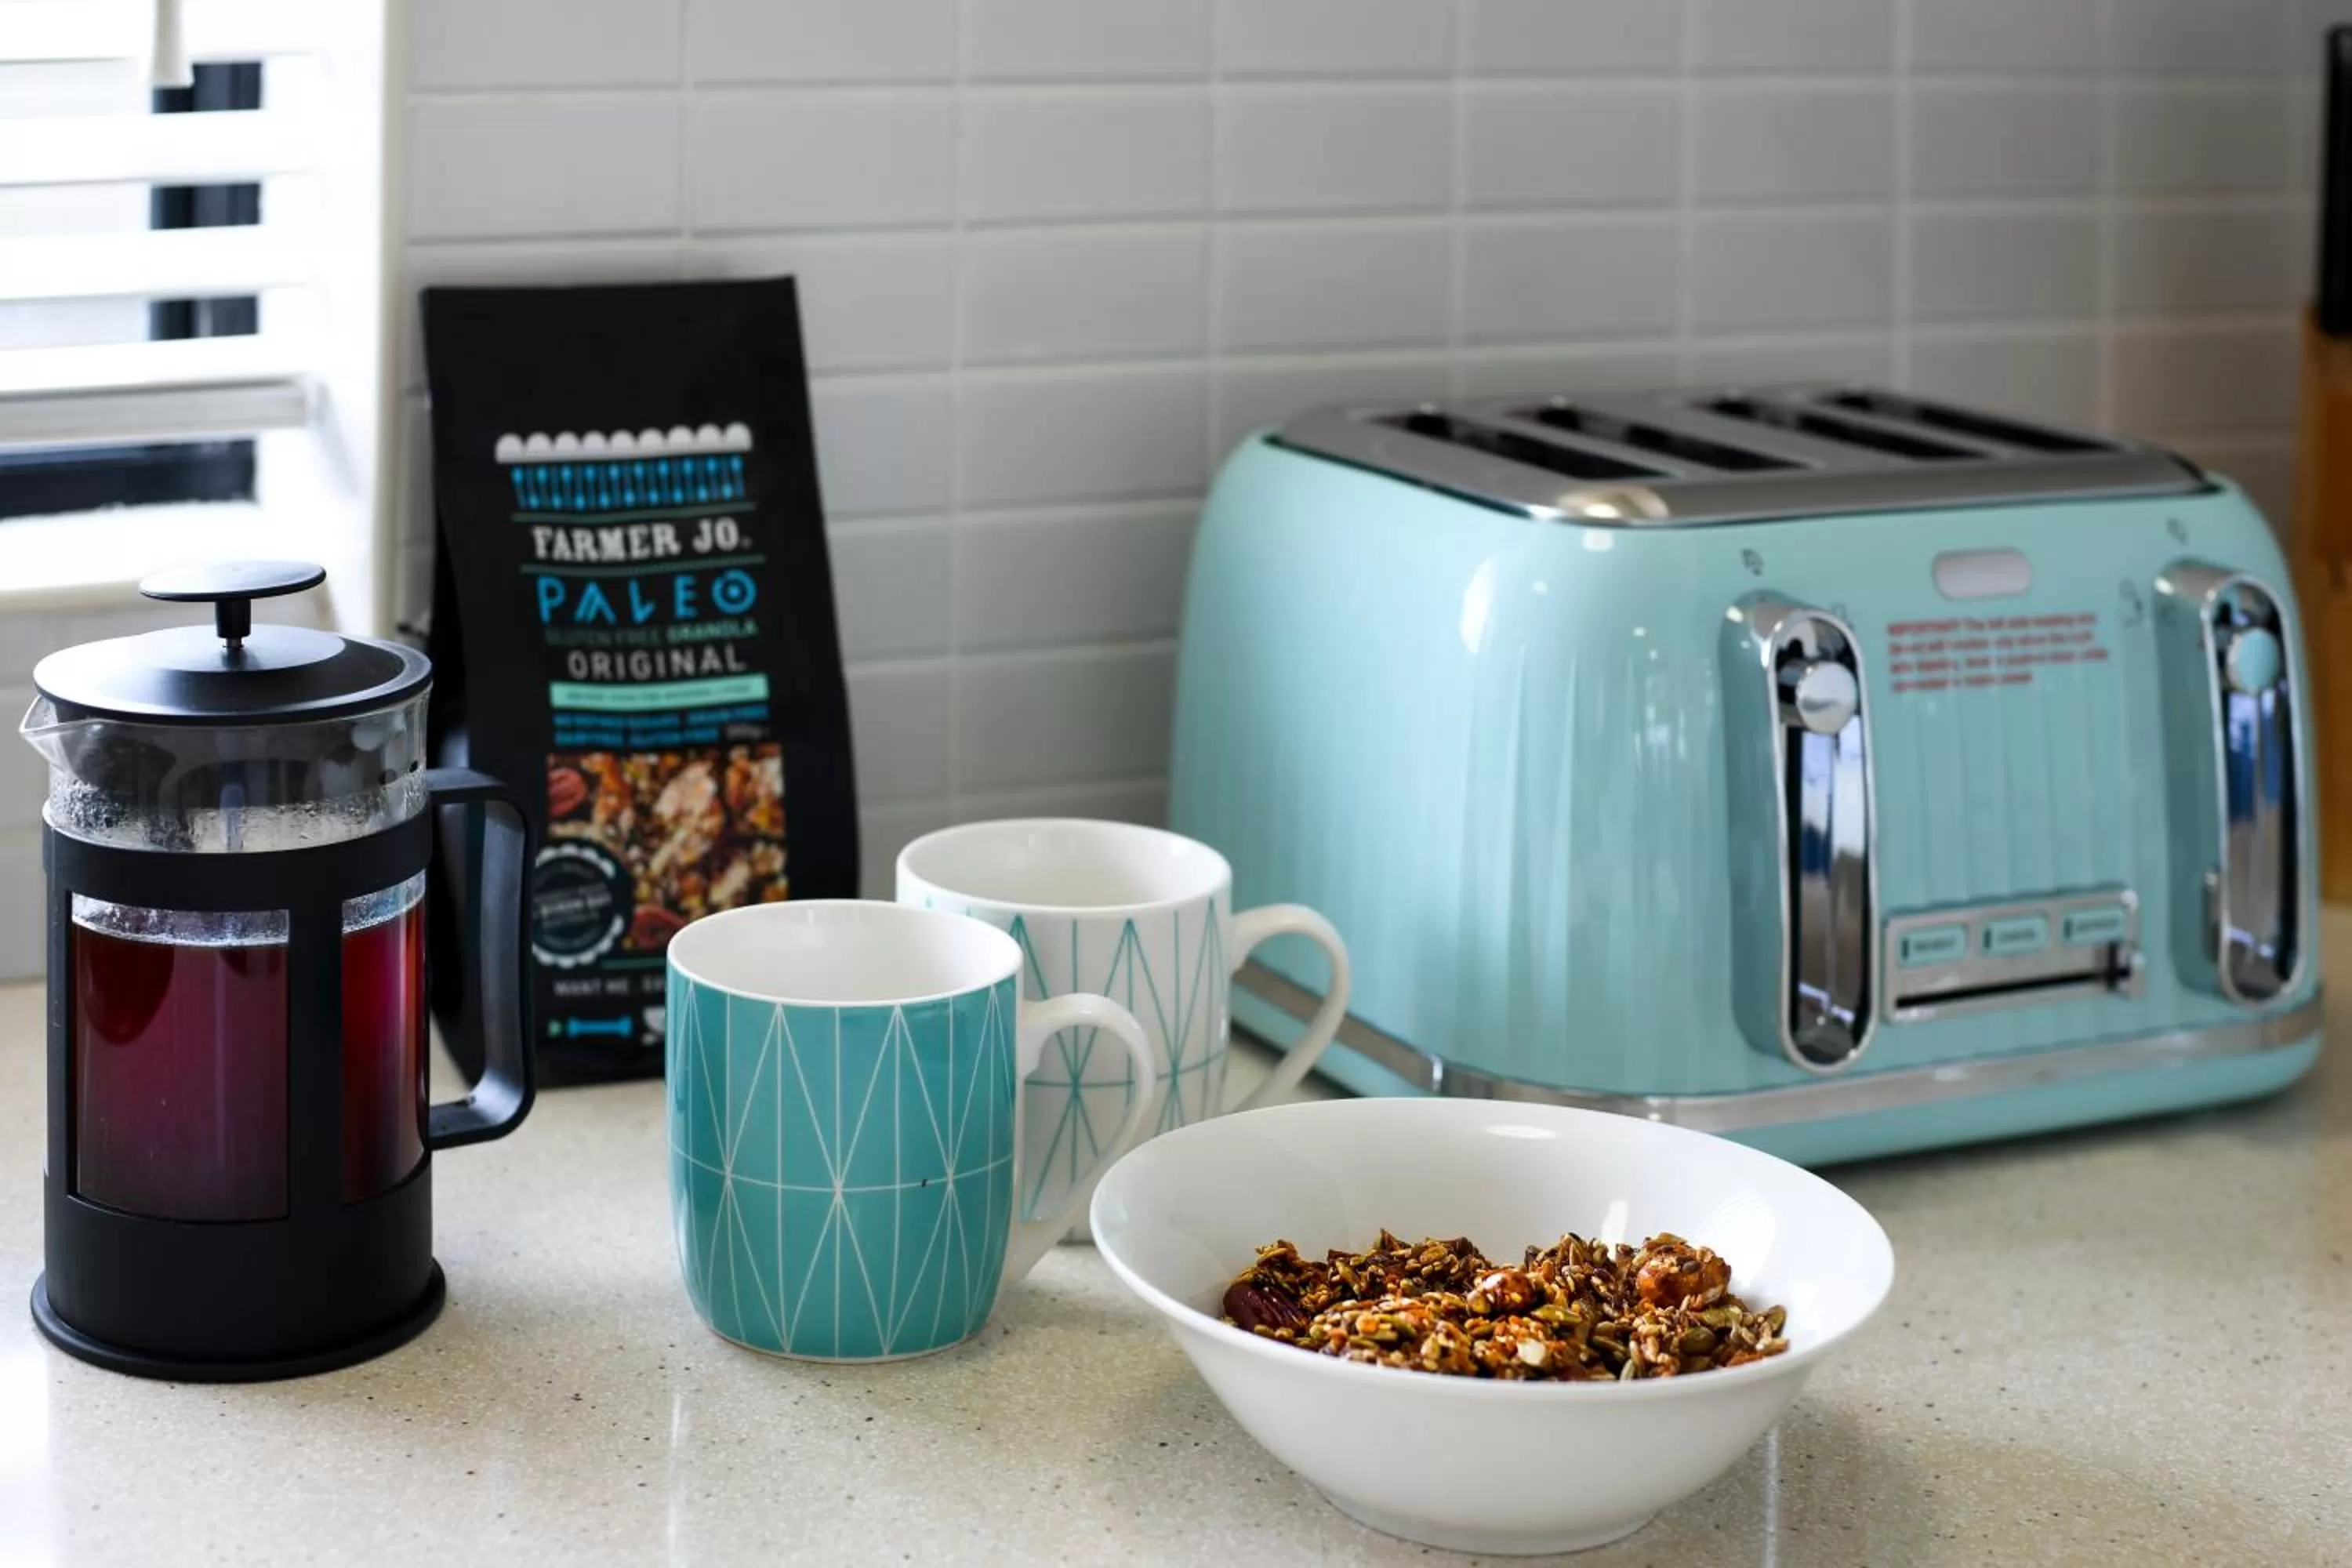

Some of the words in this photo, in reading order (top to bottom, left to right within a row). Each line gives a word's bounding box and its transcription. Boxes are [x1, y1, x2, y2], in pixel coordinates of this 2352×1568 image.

[532, 521, 681, 562] FARMER
[536, 568, 757, 624] PALEO
[566, 643, 747, 681] ORIGINAL
